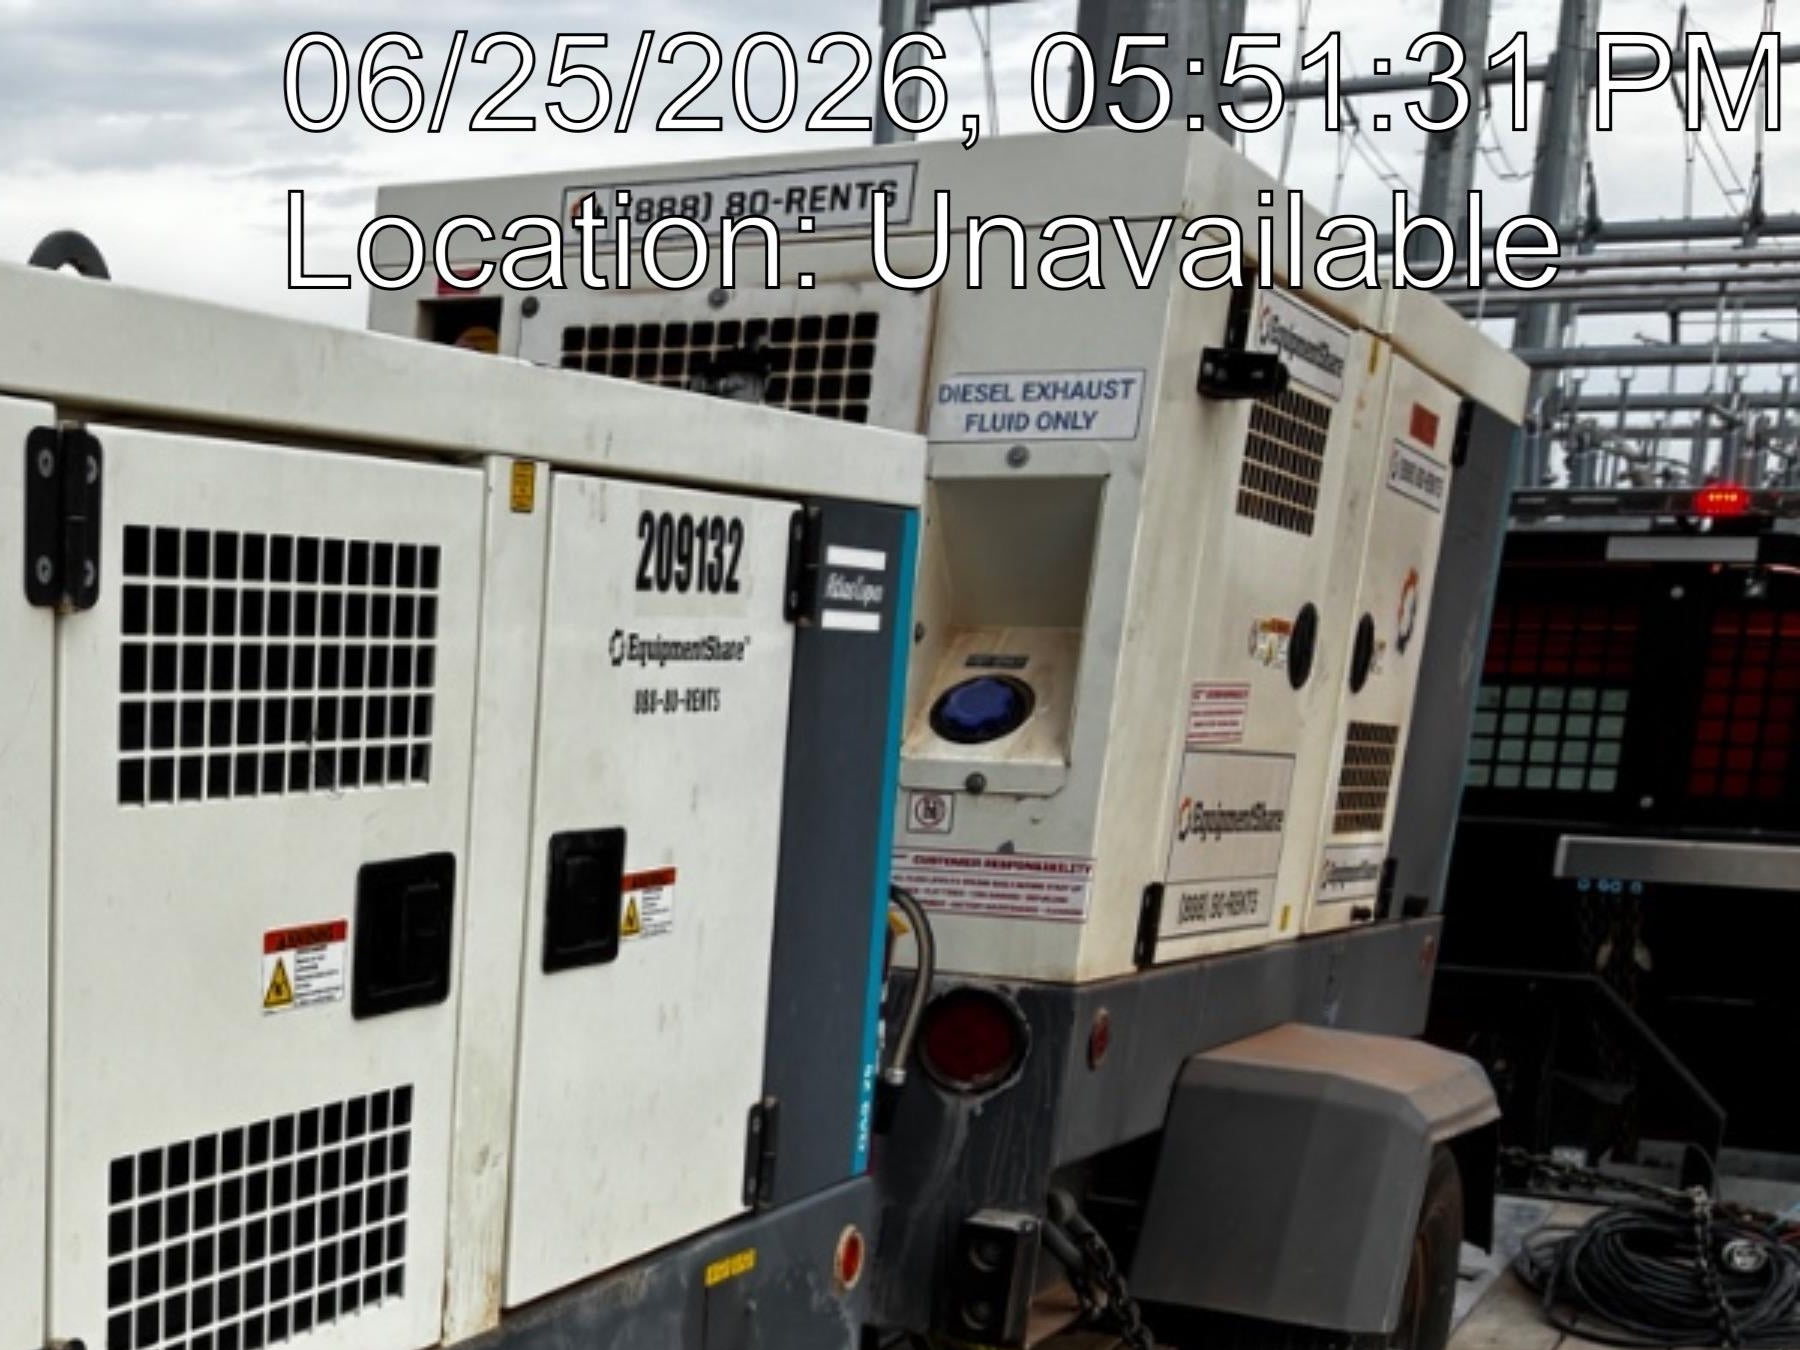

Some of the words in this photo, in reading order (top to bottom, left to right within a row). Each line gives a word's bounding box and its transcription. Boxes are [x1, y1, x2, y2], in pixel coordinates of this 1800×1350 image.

[938, 383, 1014, 404] DIESEL
[1022, 378, 1136, 401] EXHAUST
[965, 411, 1030, 433] FLUID
[1035, 410, 1098, 431] ONLY
[635, 509, 745, 594] 209132
